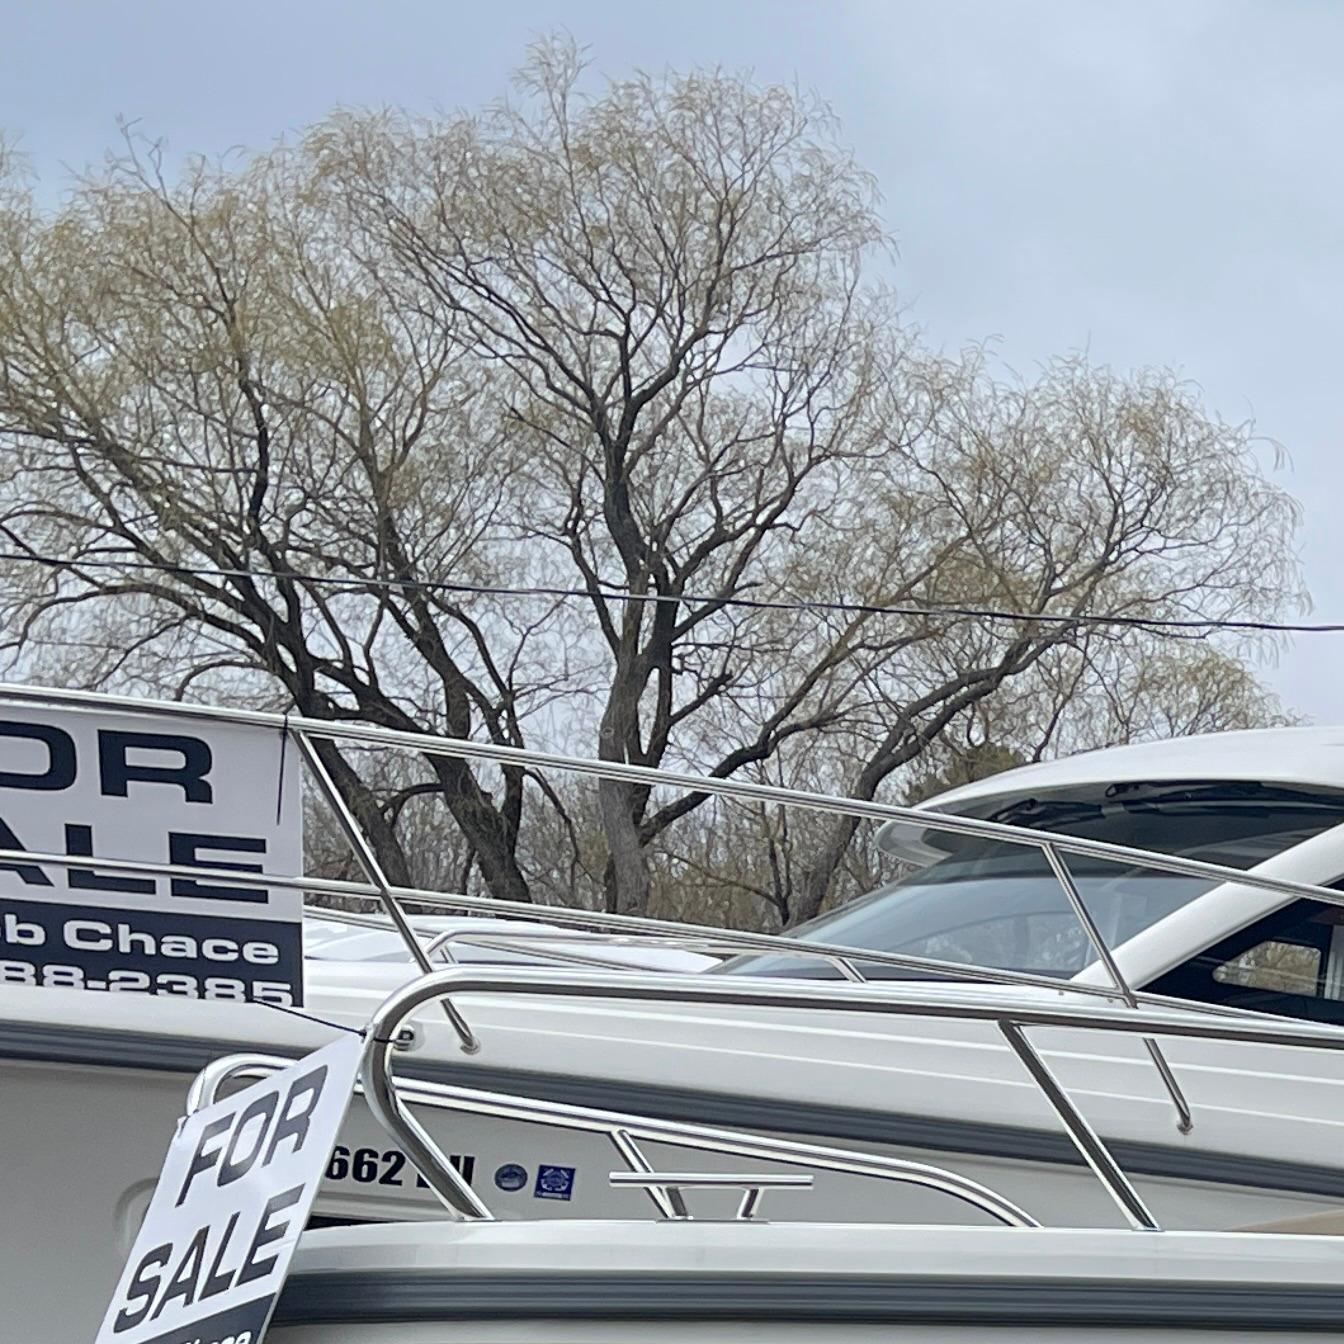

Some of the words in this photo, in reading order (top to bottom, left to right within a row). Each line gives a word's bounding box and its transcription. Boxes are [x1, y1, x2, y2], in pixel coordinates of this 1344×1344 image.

[62, 920, 279, 965] Chace
[174, 1063, 328, 1208] FOR
[113, 1183, 305, 1334] SALE
